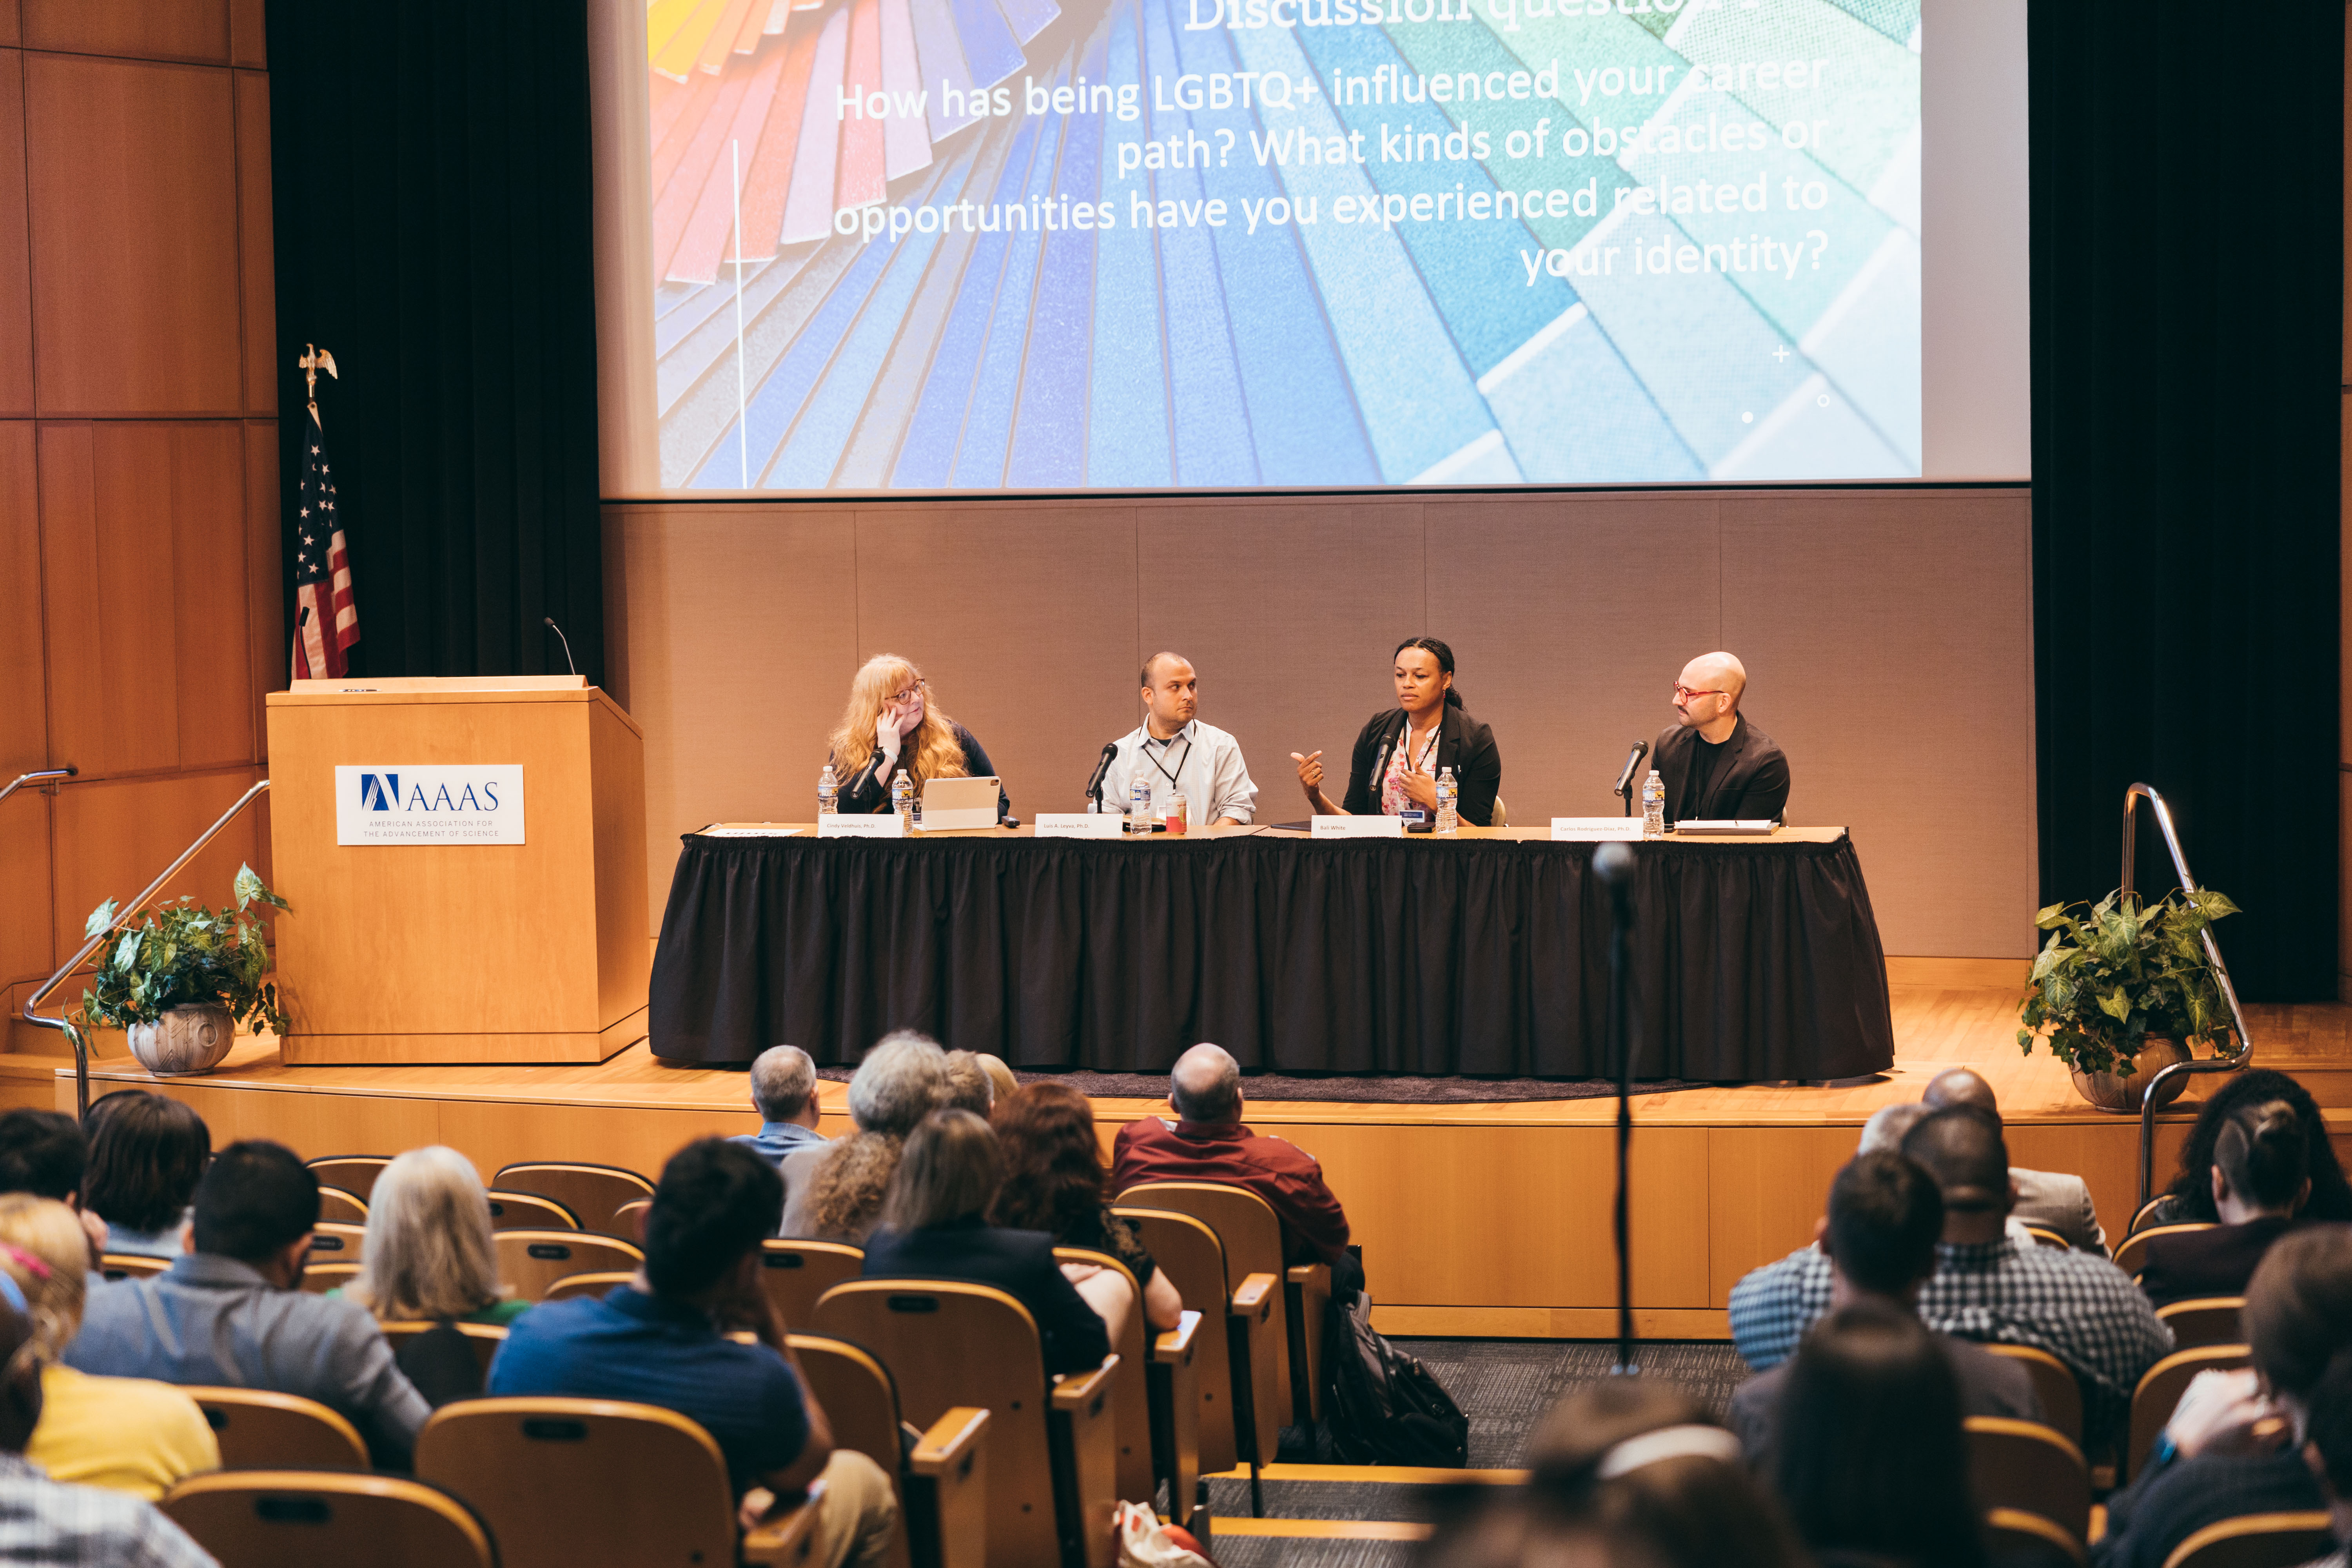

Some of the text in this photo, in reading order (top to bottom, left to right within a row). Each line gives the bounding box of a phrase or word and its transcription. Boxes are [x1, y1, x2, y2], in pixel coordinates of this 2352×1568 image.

[836, 57, 1829, 122] How has being LGBTQ+ influenced your career
[1117, 113, 1829, 178] path? What kinds of obstacles or
[834, 174, 1829, 243] opportunities have you experienced related to
[1520, 230, 1829, 287] your identity?
[405, 782, 499, 811] AAAS
